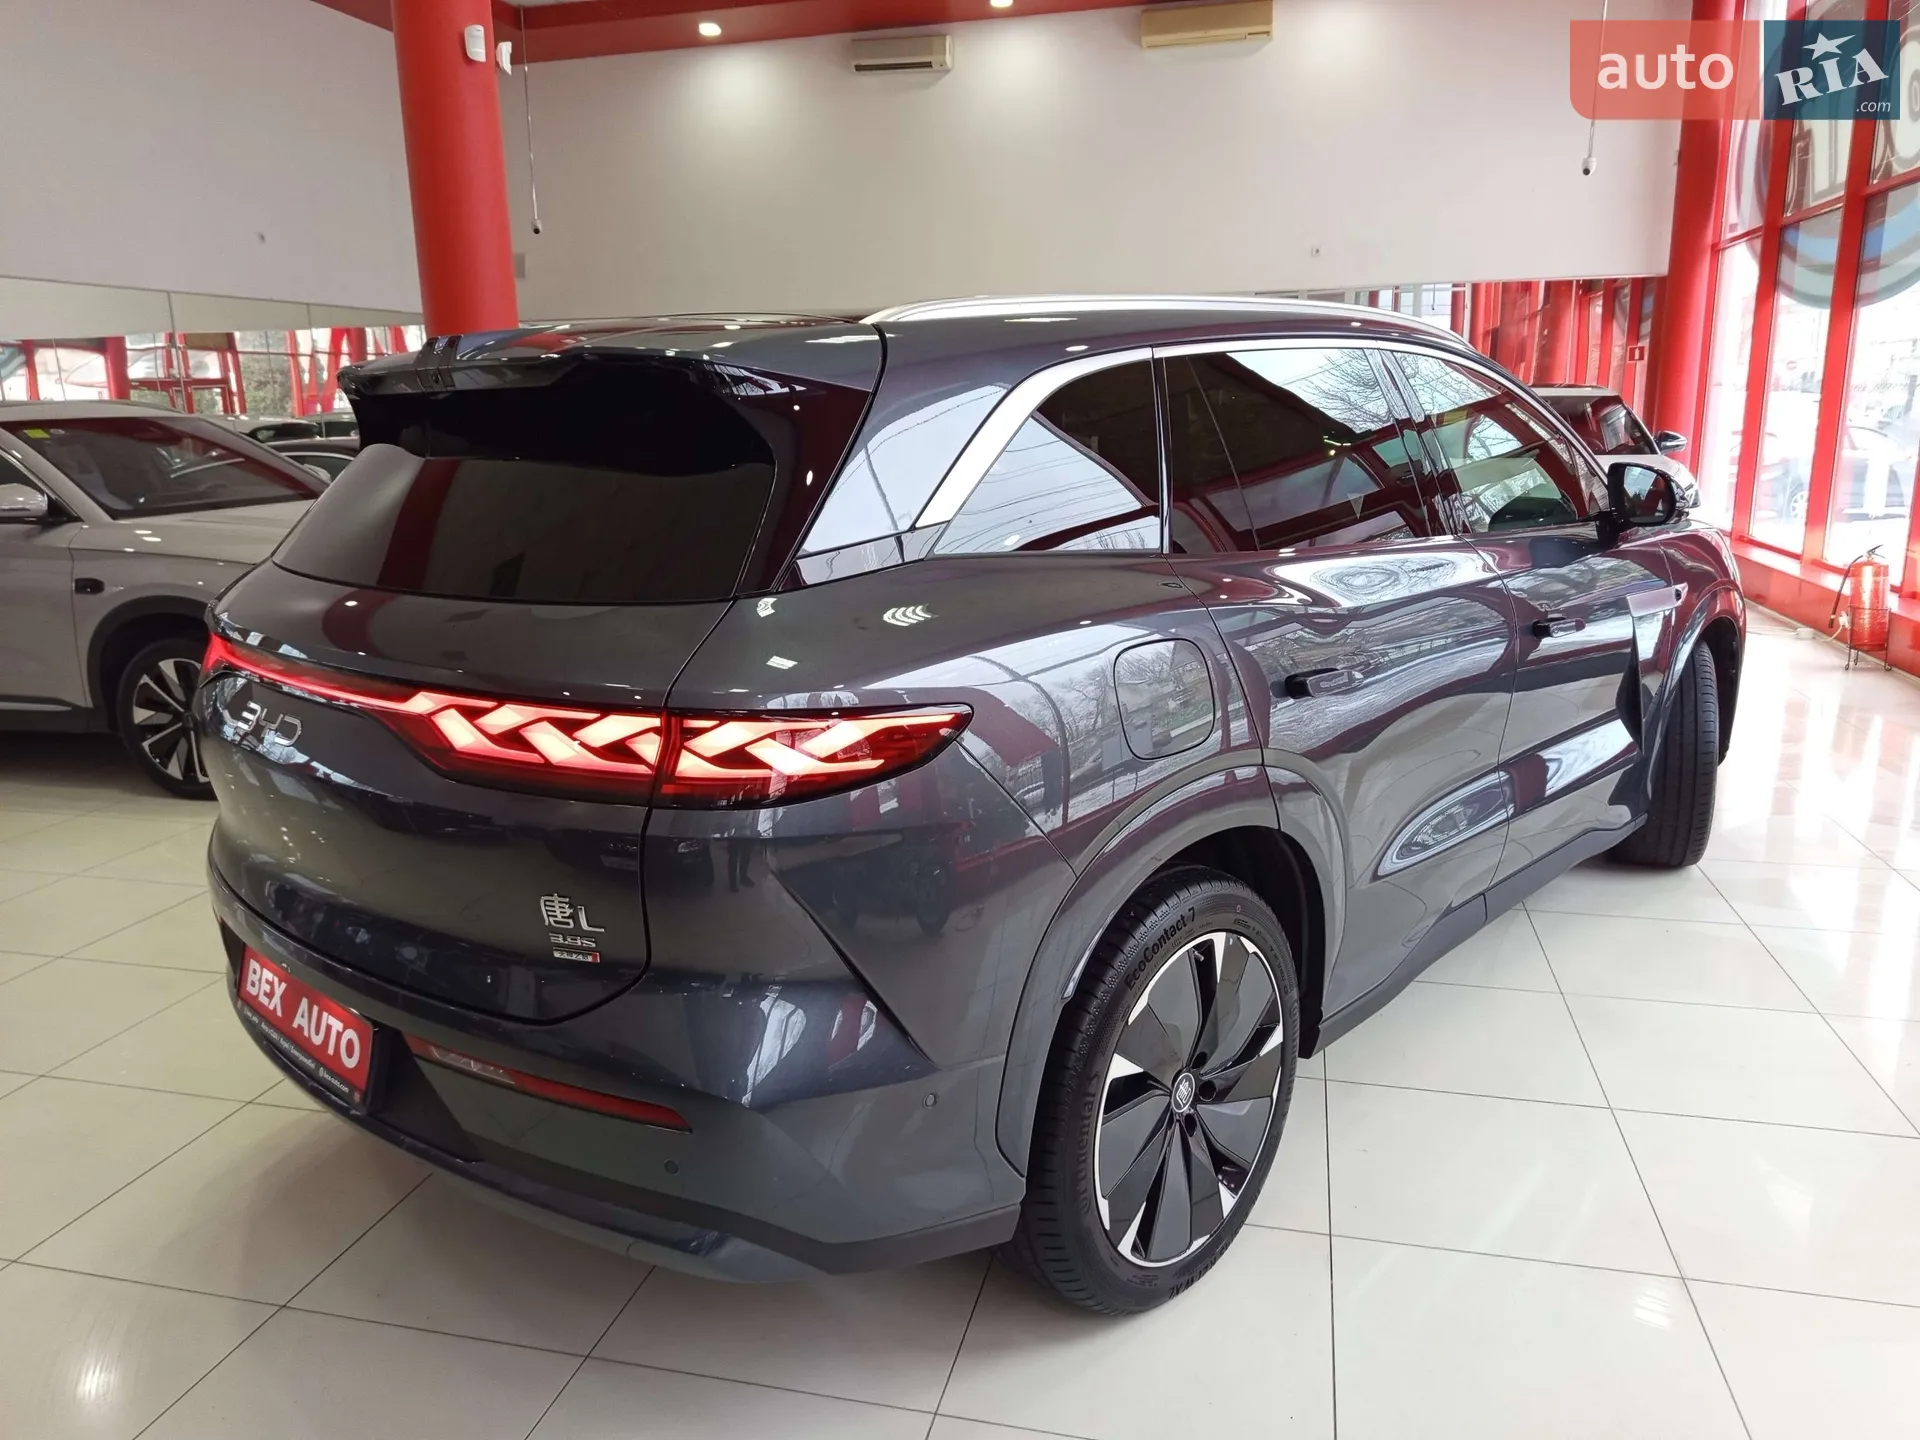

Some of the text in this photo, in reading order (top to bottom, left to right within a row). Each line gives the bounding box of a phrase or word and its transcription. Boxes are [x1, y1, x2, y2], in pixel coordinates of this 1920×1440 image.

[242, 700, 302, 747] BYD
[1124, 906, 1196, 991] EcoContact 7
[246, 958, 287, 1017] BEX
[292, 996, 361, 1069] AUTO
